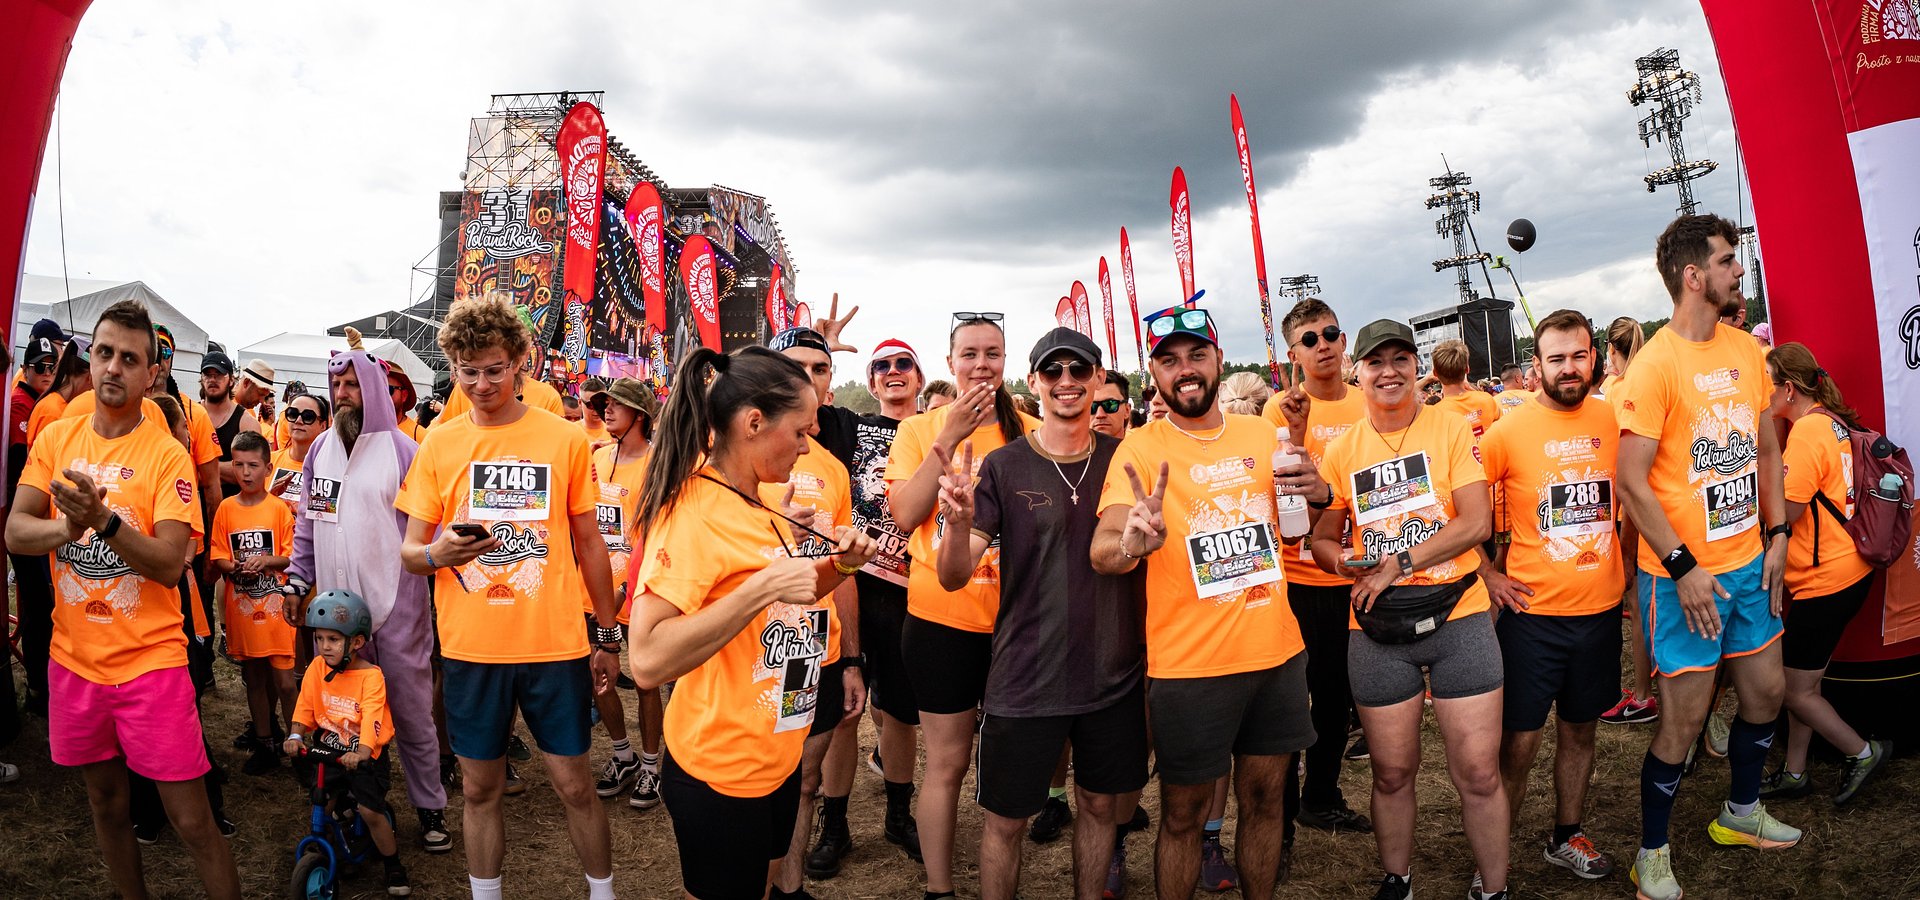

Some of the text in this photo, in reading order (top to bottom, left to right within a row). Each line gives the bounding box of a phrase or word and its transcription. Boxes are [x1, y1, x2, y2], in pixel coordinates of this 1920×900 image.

[1861, 4, 1870, 44] RODZINNA
[1869, 11, 1880, 42] FIRMA
[1856, 52, 1892, 74] Prosto
[1895, 55, 1903, 64] z
[479, 188, 532, 232] 31
[681, 214, 705, 235] 31
[484, 465, 537, 490] 2146
[1371, 459, 1408, 488] 761
[311, 478, 334, 498] 949
[1564, 482, 1600, 507] 288
[1714, 475, 1753, 509] 2994
[237, 531, 264, 549] 259
[877, 532, 909, 559] 492
[1199, 527, 1262, 562] 3062
[311, 747, 331, 756] PUKY
